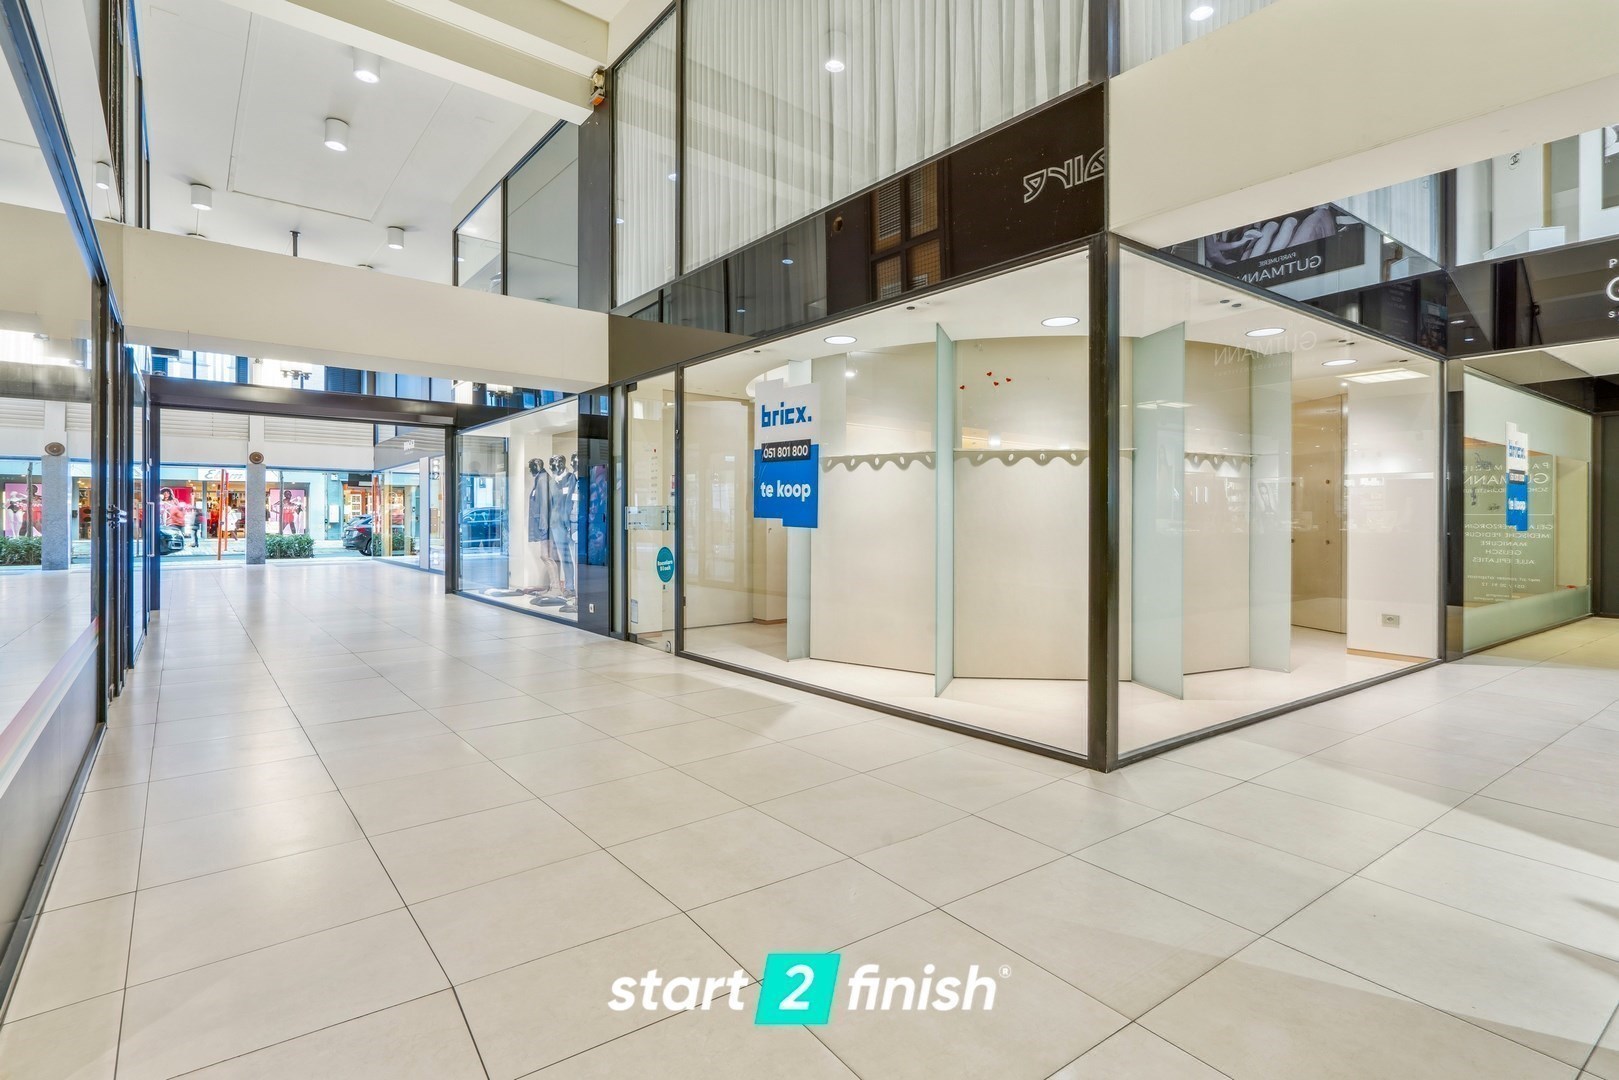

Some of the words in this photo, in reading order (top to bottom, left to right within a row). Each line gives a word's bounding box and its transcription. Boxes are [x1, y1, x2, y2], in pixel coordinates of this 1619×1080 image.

[763, 447, 776, 459] 051
[777, 446, 791, 457] 801
[791, 444, 808, 456] 800
[760, 482, 773, 498] te
[776, 480, 811, 502] koop
